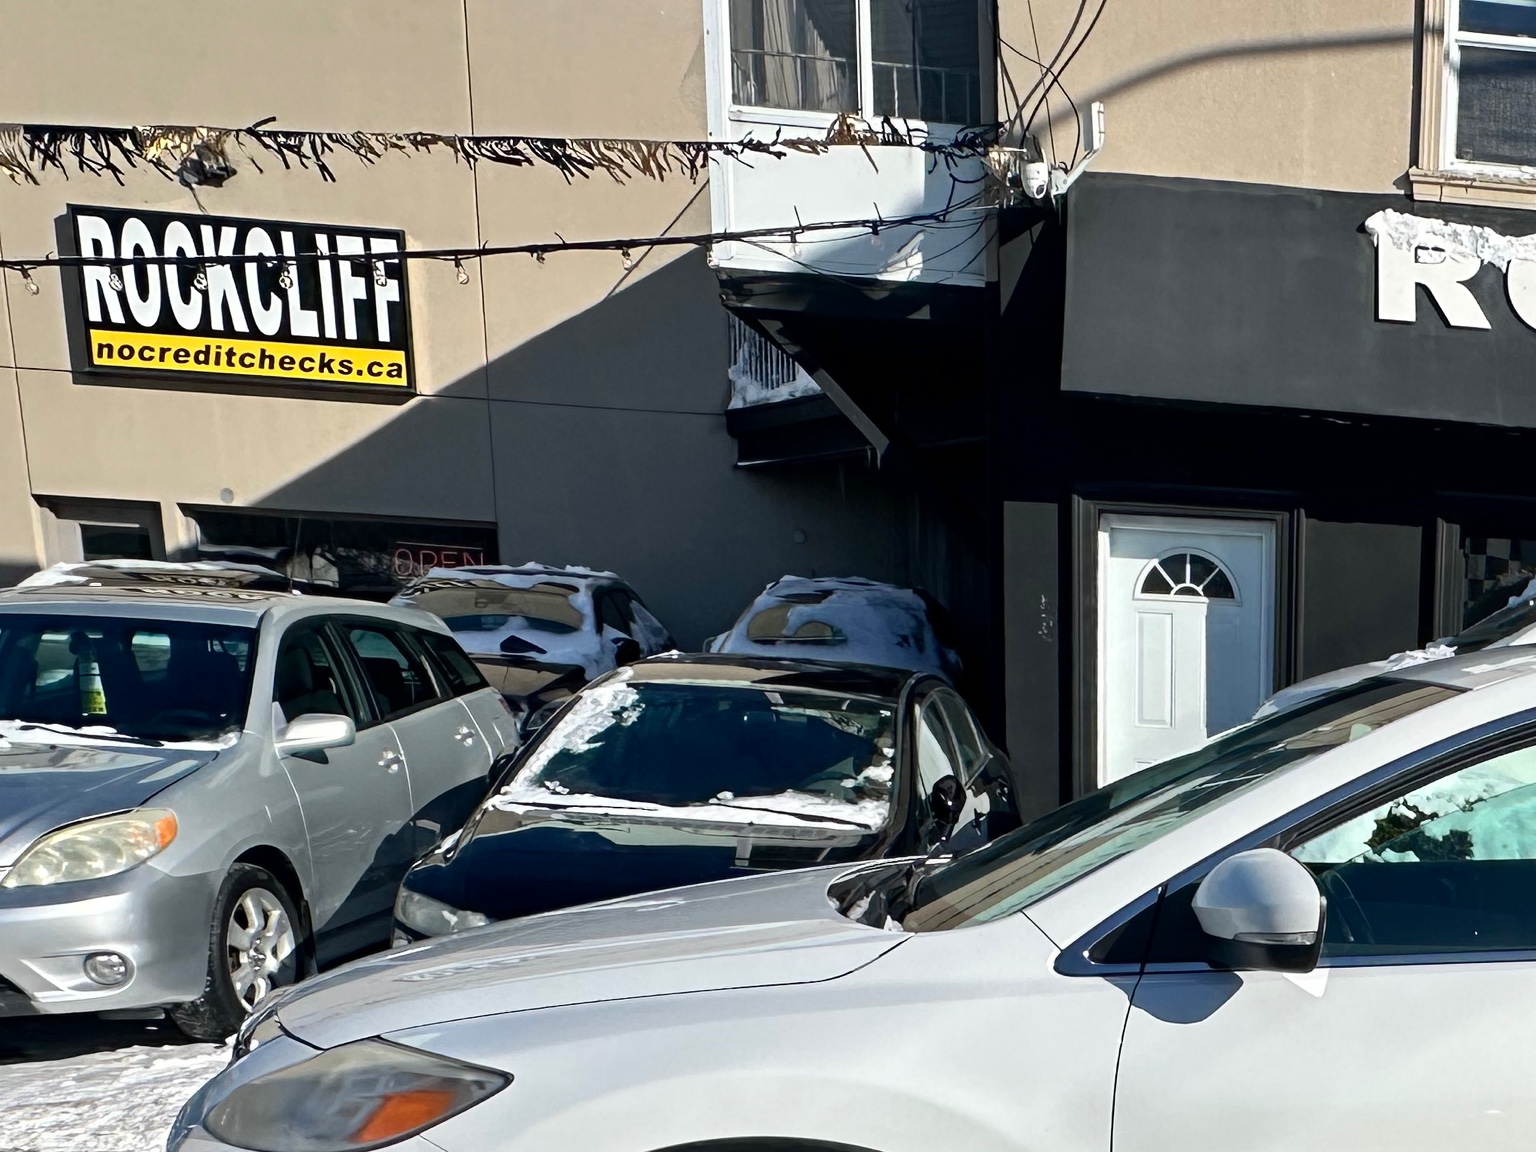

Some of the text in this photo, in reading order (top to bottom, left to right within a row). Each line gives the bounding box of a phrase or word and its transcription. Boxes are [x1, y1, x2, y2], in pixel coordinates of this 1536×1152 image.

[77, 215, 400, 342] ROCKCLIFF
[96, 341, 404, 380] nocreditchecks.ca
[395, 548, 484, 577] OPEN
